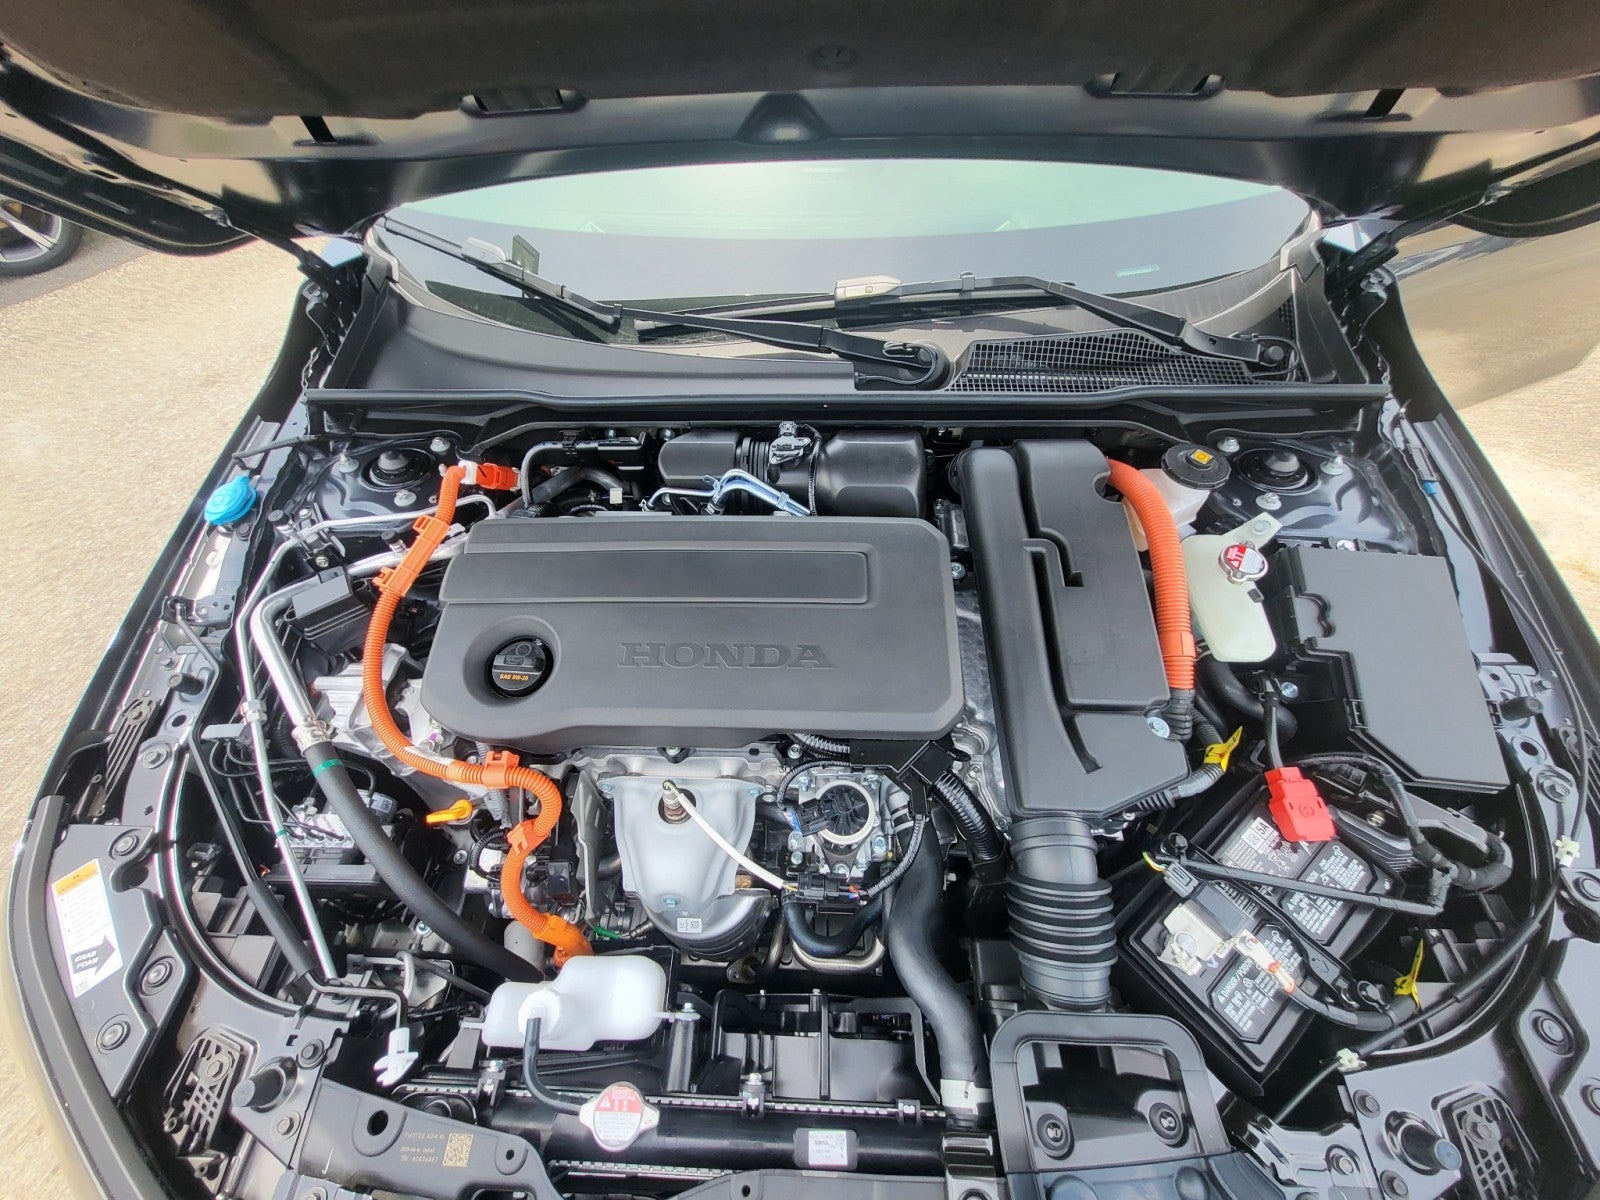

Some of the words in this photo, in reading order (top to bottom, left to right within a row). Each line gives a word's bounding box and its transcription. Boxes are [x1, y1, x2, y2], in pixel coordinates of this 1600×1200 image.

[618, 642, 836, 669] HONDA
[75, 950, 97, 962] GRAB
[76, 956, 99, 969] FOAM
